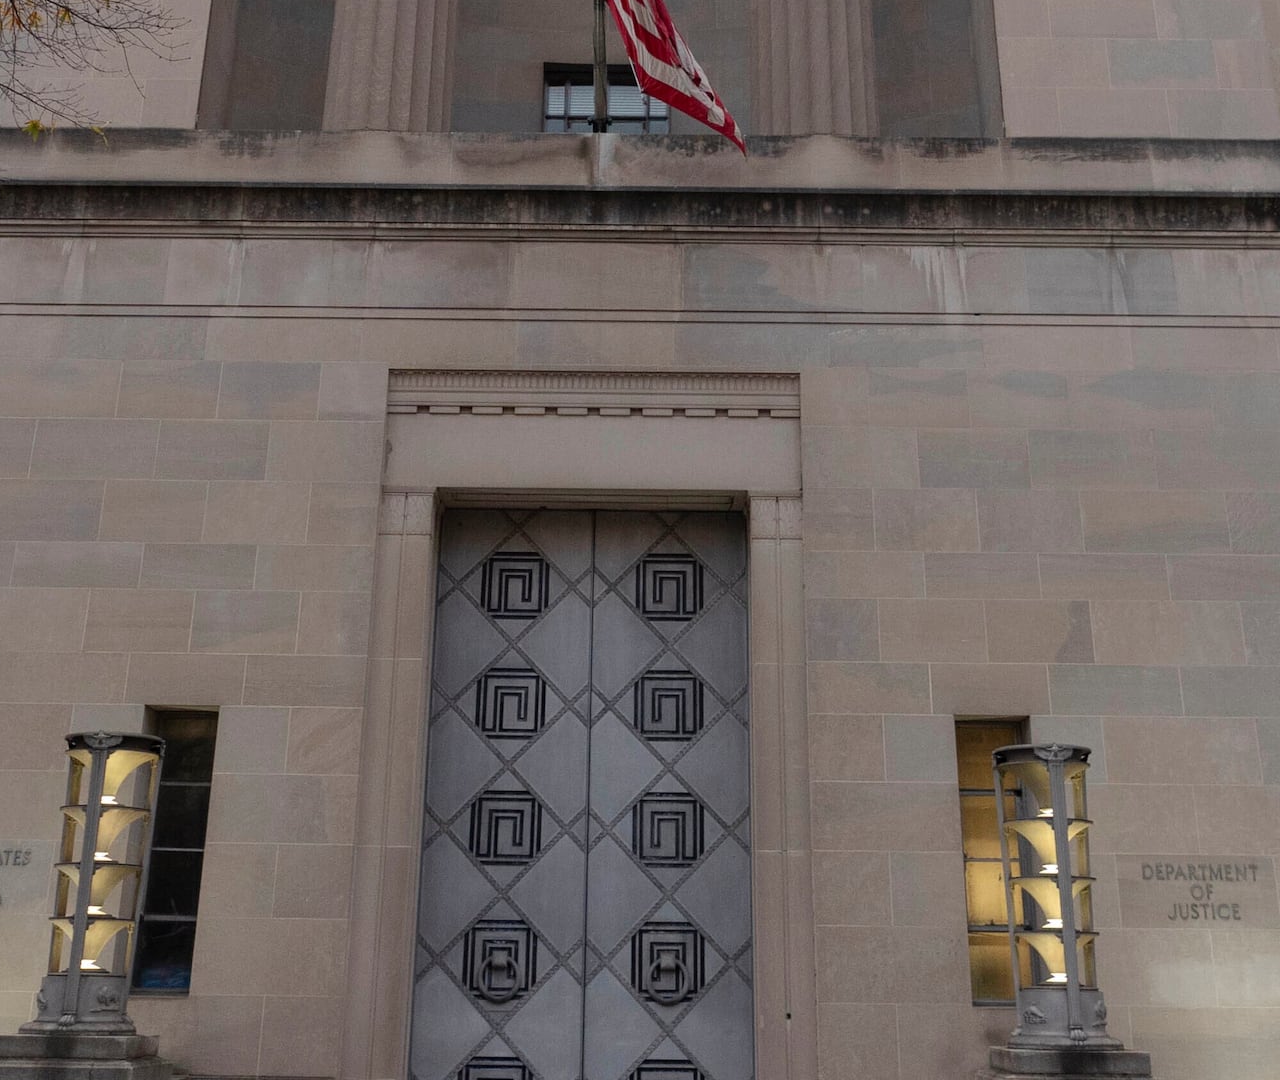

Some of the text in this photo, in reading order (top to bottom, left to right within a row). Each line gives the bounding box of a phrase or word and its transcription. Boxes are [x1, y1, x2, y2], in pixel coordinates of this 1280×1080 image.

[1141, 863, 1258, 882] DEPARTMENT
[1190, 883, 1214, 900] OF
[1167, 903, 1241, 920] JUSTICE
